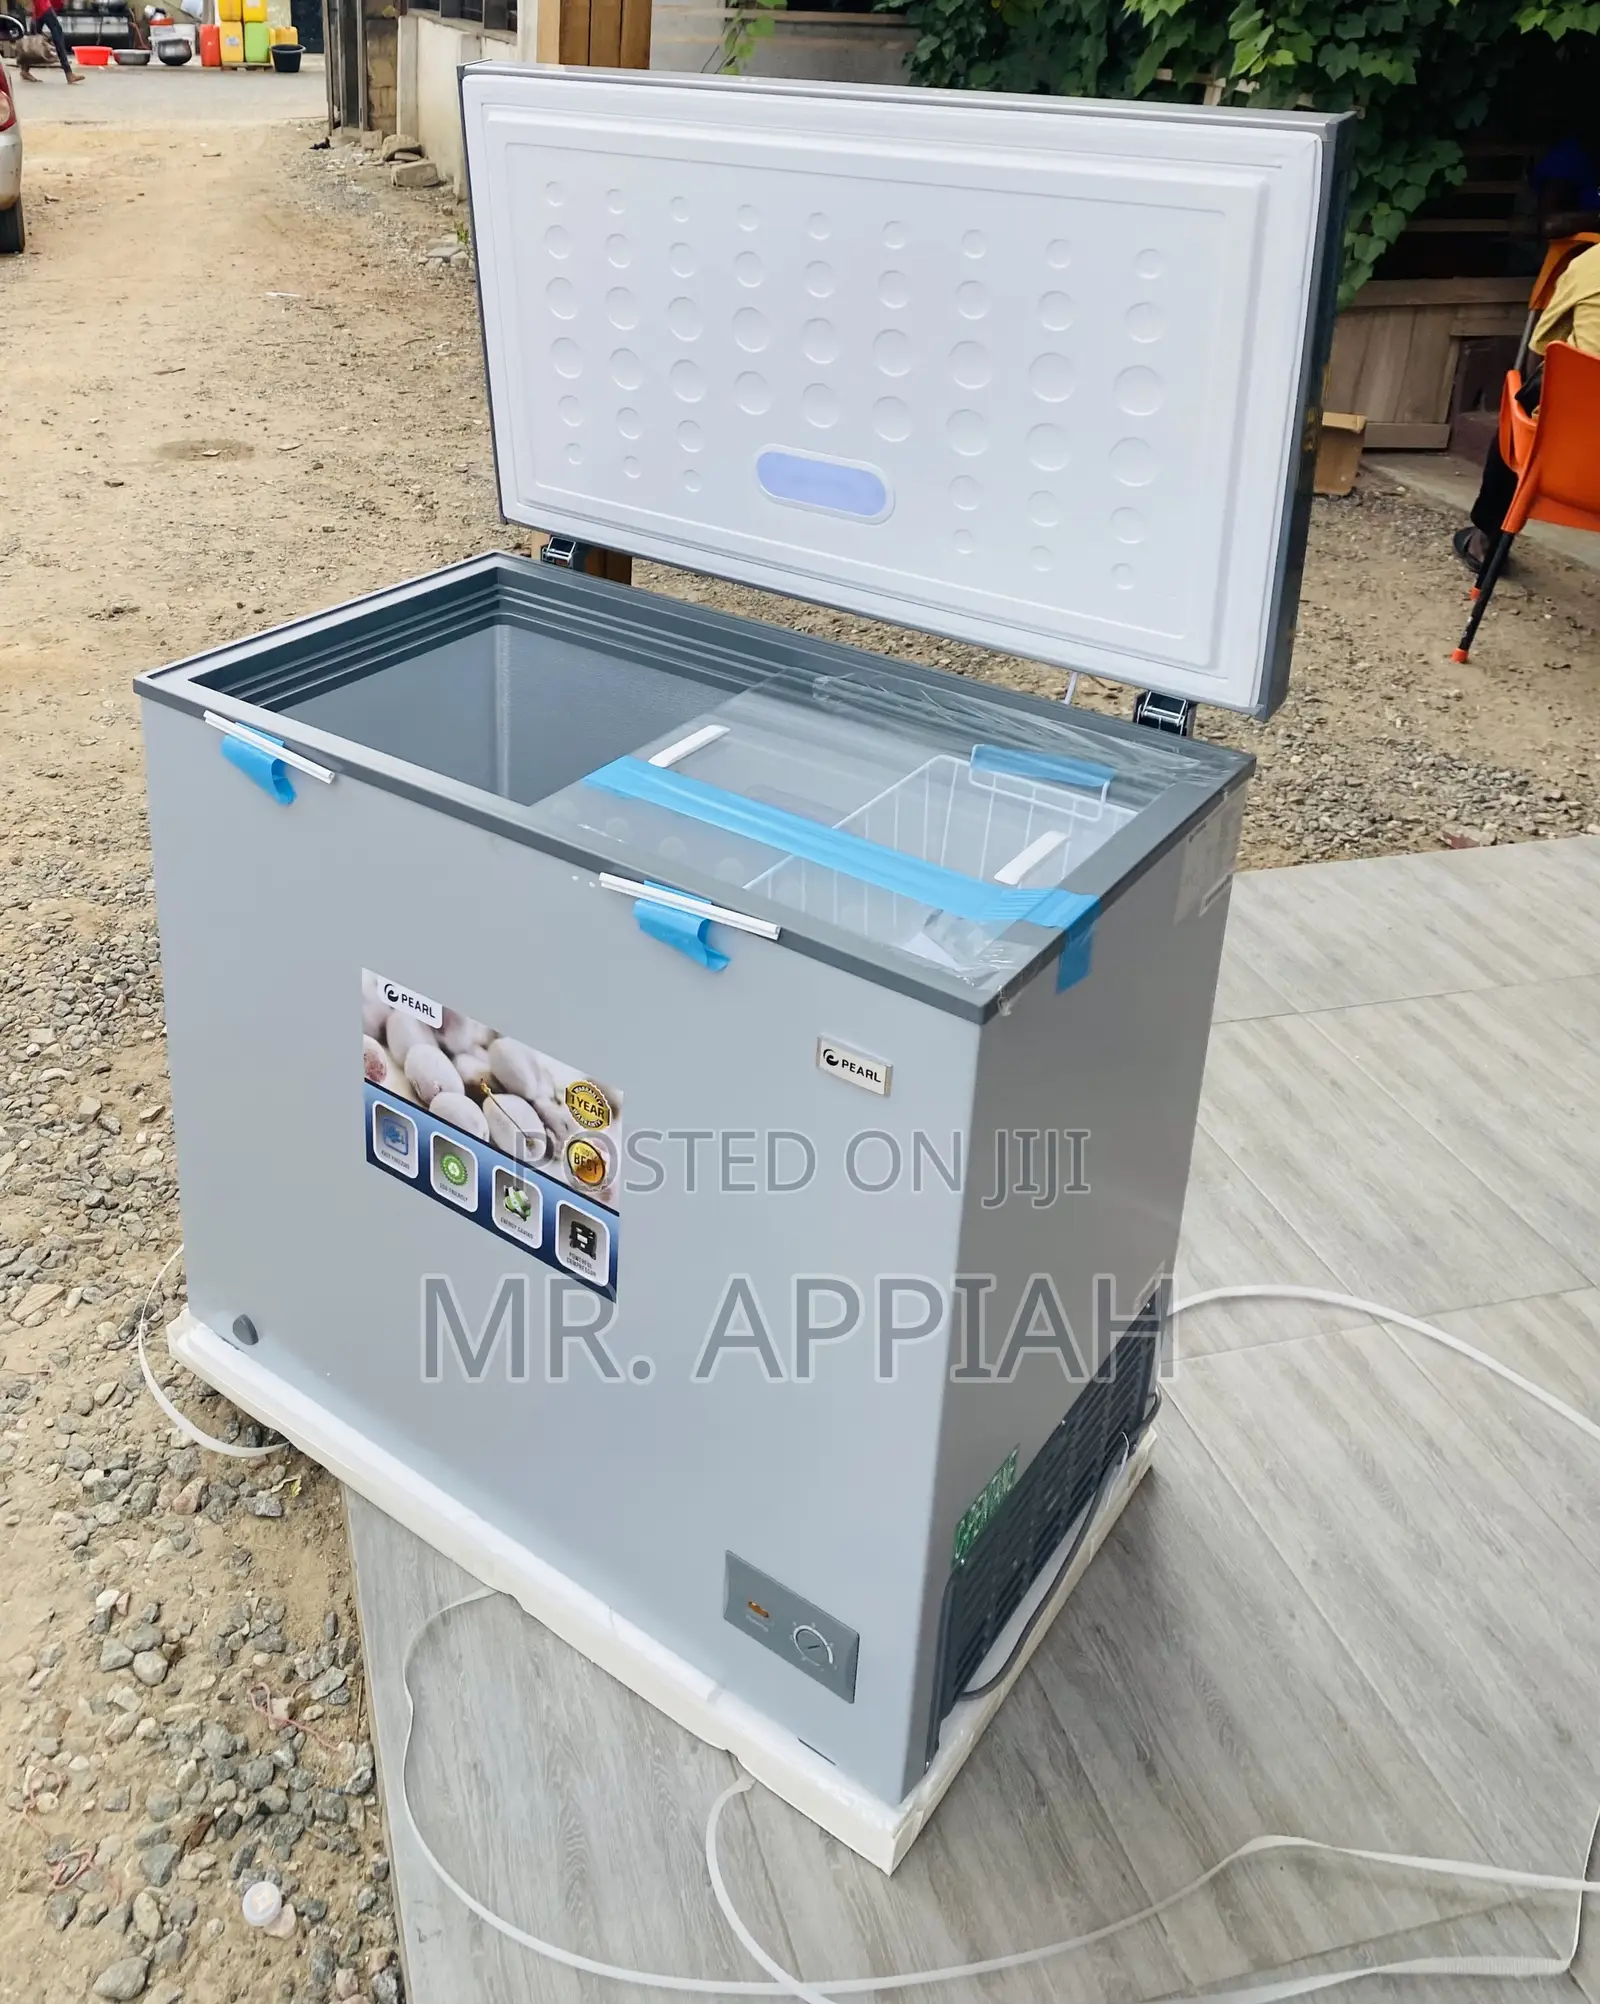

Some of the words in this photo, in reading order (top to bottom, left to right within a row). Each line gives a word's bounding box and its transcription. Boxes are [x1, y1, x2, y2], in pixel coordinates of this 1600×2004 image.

[401, 993, 436, 1019] PEARL
[841, 1058, 882, 1084] PEARL
[576, 1096, 605, 1119] YEAR
